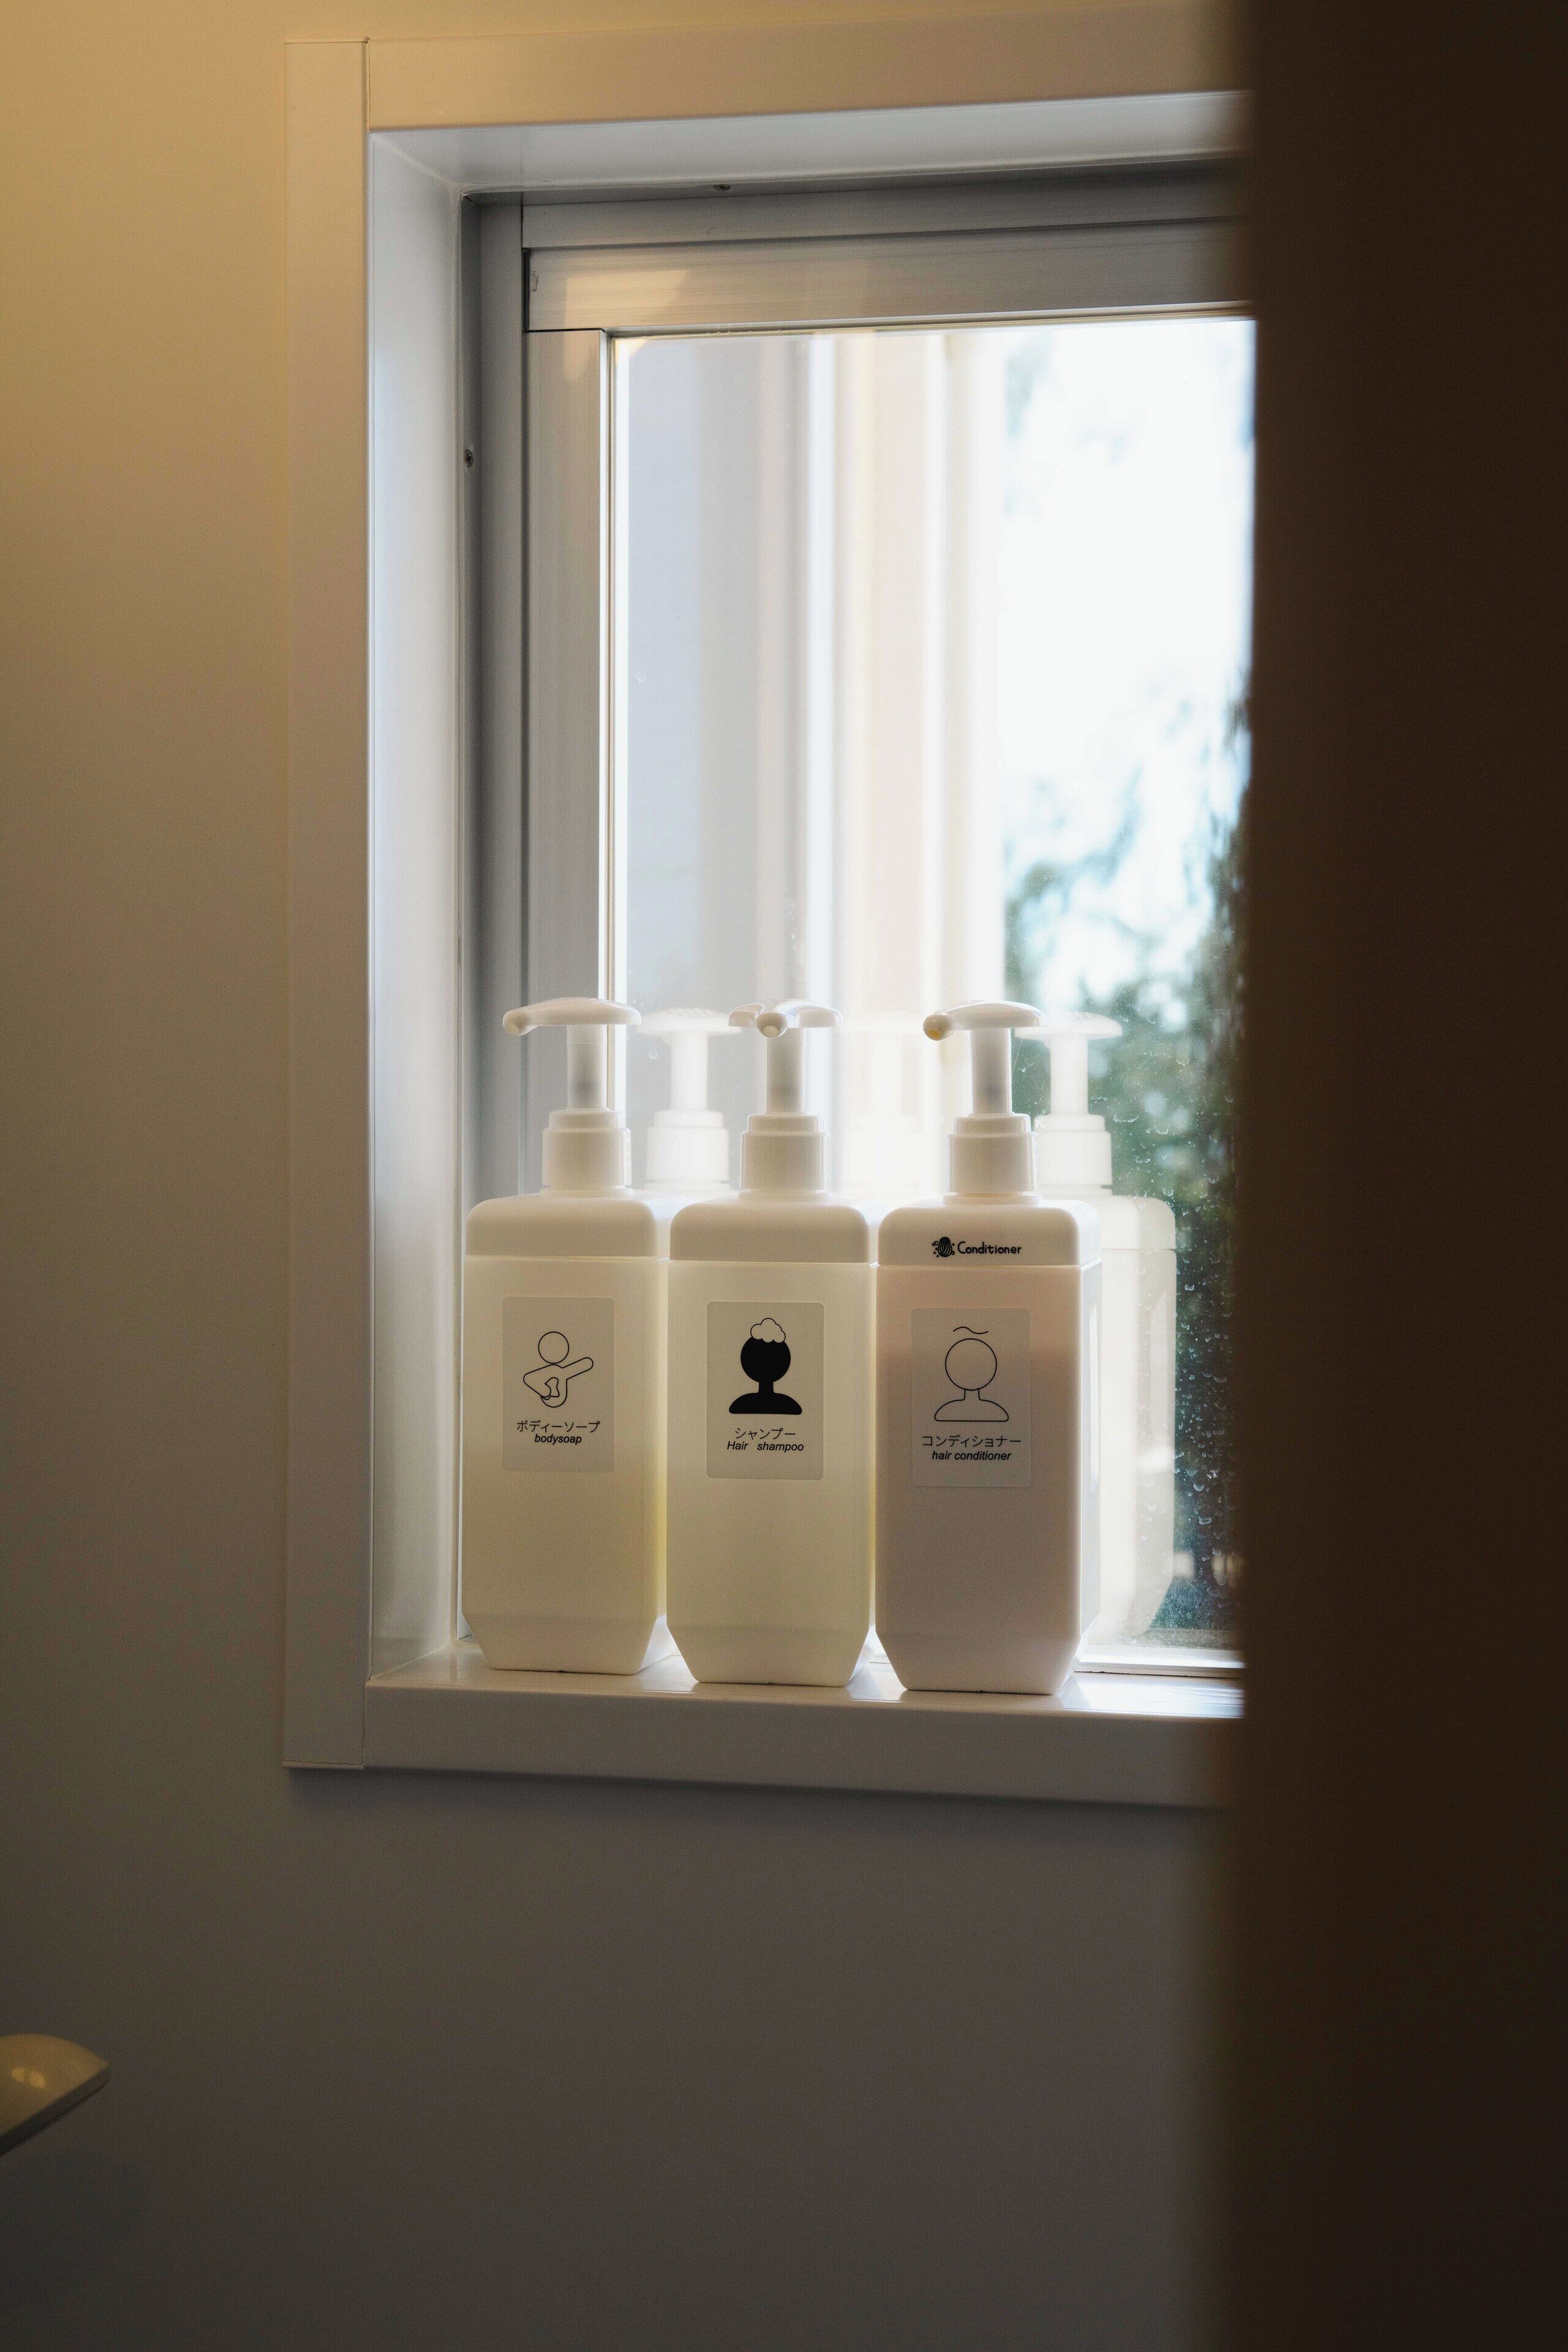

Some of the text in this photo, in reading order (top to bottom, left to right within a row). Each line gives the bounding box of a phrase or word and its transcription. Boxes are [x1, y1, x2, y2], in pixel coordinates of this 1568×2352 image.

[957, 1241, 1022, 1254] Conditioner
[516, 1420, 601, 1433] ボディーソープ
[534, 1433, 582, 1446] bodysoap
[734, 1428, 796, 1440] シャンプー
[726, 1441, 804, 1453] Hair shampoo
[922, 1434, 1022, 1448] コンディショナー
[932, 1450, 1012, 1461] hair conditioner
